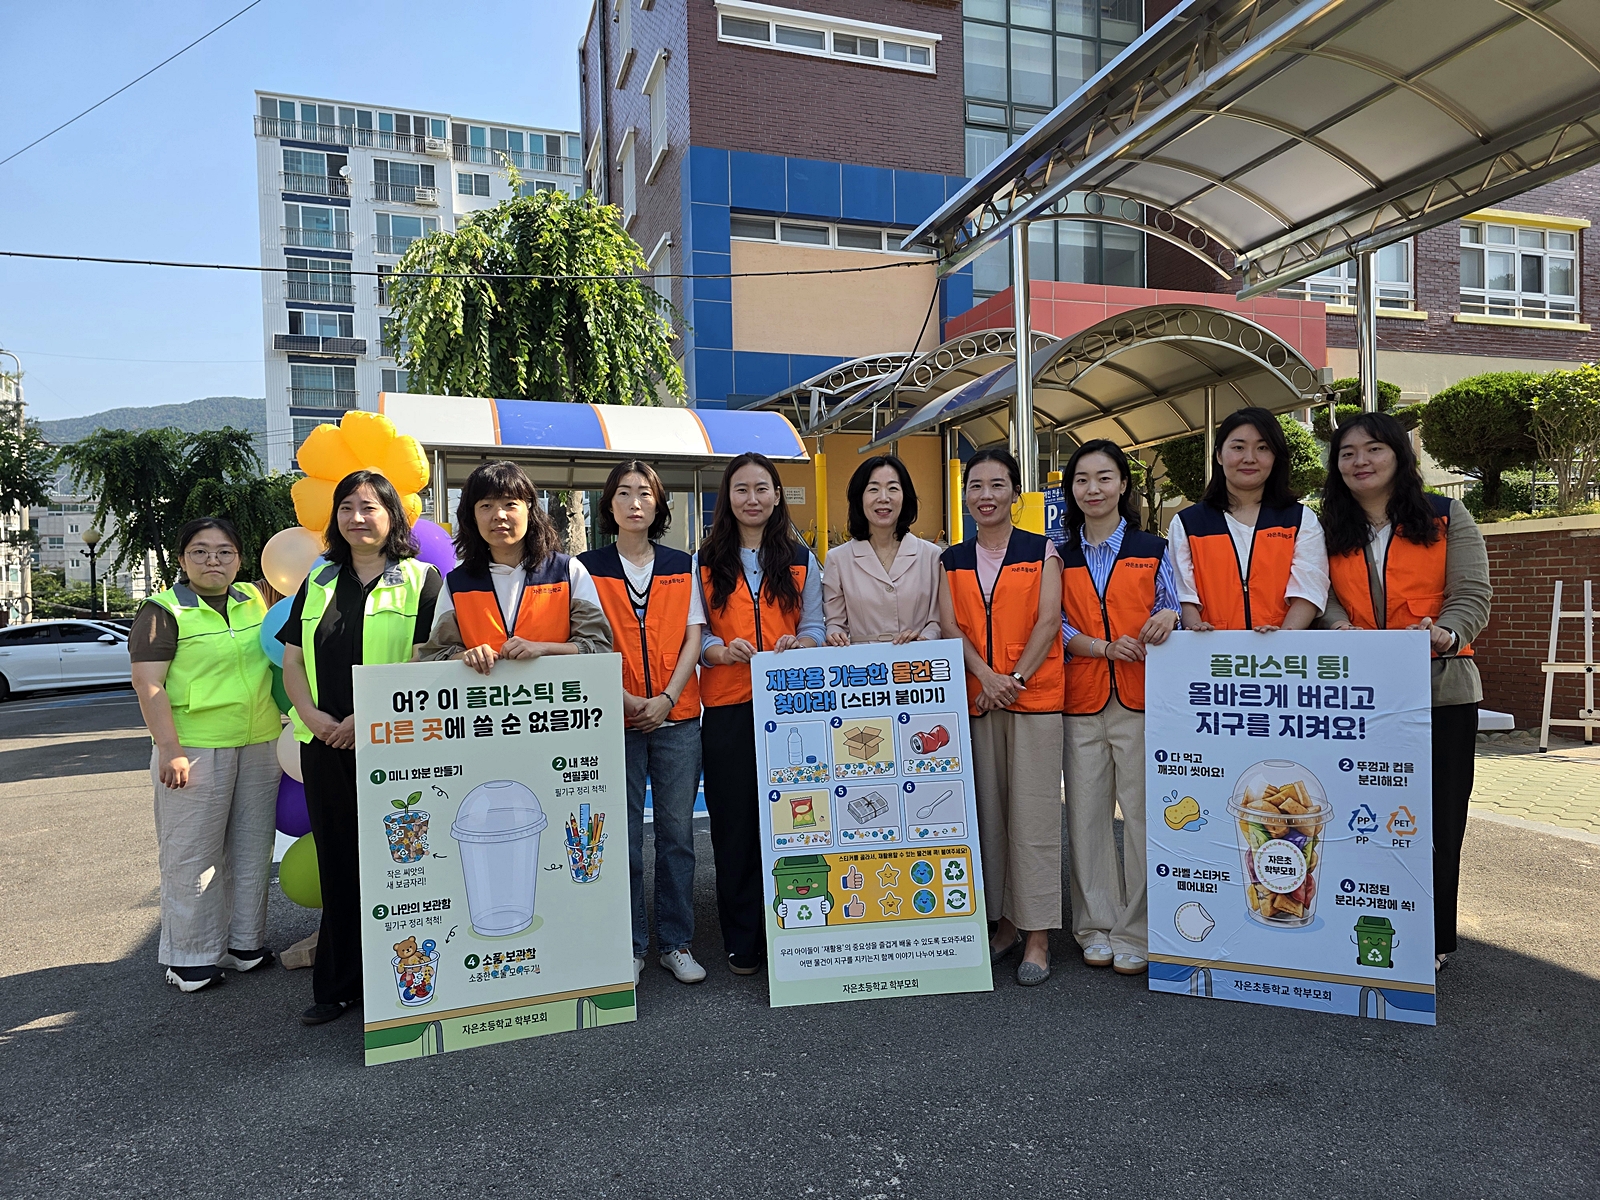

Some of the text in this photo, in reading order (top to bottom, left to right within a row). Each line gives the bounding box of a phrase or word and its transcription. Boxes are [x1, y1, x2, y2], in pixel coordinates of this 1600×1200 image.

[1048, 504, 1058, 529] P
[1210, 654, 1349, 680] 플라스틱 통!
[766, 659, 951, 691] 재활용 가능한 물건을
[392, 680, 589, 714] 어? 이 플라스틱 통,
[774, 687, 946, 715] 찾아라! [스티커 붙이기]
[1188, 682, 1376, 711] 올바르게 버리고
[370, 707, 604, 745] 다른 곳에 쓸 순 없을까?
[1195, 712, 1367, 740] 지구를 지켜요!
[568, 757, 578, 770] 내
[580, 756, 599, 768] 책상
[1170, 753, 1182, 763] 다
[1183, 753, 1202, 764] 먹고
[388, 768, 409, 783] 미니
[411, 766, 432, 781] 화분
[433, 764, 463, 779] 만들기
[1157, 764, 1225, 778] 깨끗이 씻어요!
[1357, 761, 1390, 774] 뚜껑과
[1393, 761, 1414, 774] 컵을
[562, 769, 599, 783] 연필꽂이
[1358, 774, 1408, 788] 분리해요!
[554, 784, 607, 798] 필기구 정리 척척!
[1356, 816, 1370, 825] PP
[1394, 818, 1410, 828] PET
[1356, 836, 1370, 845] PP
[1392, 838, 1412, 848] PET
[1267, 854, 1292, 866] 자은초
[386, 866, 425, 879] 작은 씨앗의
[1172, 867, 1191, 879] 라벨
[1192, 869, 1231, 882] 스티커도
[1264, 865, 1296, 876] 학부모회
[386, 877, 427, 891] 새 보금자리!
[1176, 880, 1218, 894] 떼어내요!
[1358, 882, 1390, 896] 지정된
[391, 902, 420, 917] 나만의
[422, 898, 452, 912] 보관함
[1335, 894, 1416, 912] 분리수거함에 쏙!
[384, 916, 442, 932] 필기구 정리 척척!
[780, 948, 793, 956] 우리
[794, 946, 820, 956] 아이들이
[852, 941, 878, 952] 중요성을
[878, 940, 898, 950] 즐겁게
[898, 938, 912, 948] 배울
[913, 938, 920, 946] 수
[921, 936, 940, 946] 있도록
[941, 934, 975, 944] 도와주세요!
[505, 948, 537, 963] 보관함
[799, 948, 958, 968] 어떤 물건이 지구를 지키는지 함께 이야기 나누어 보세요.
[468, 970, 490, 983] 소중한
[842, 978, 919, 994] 자은초등학교 학부모회
[1234, 980, 1332, 1001] 자은초등학교 학부모회
[462, 1012, 548, 1035] 자은초등학교 학부모회
